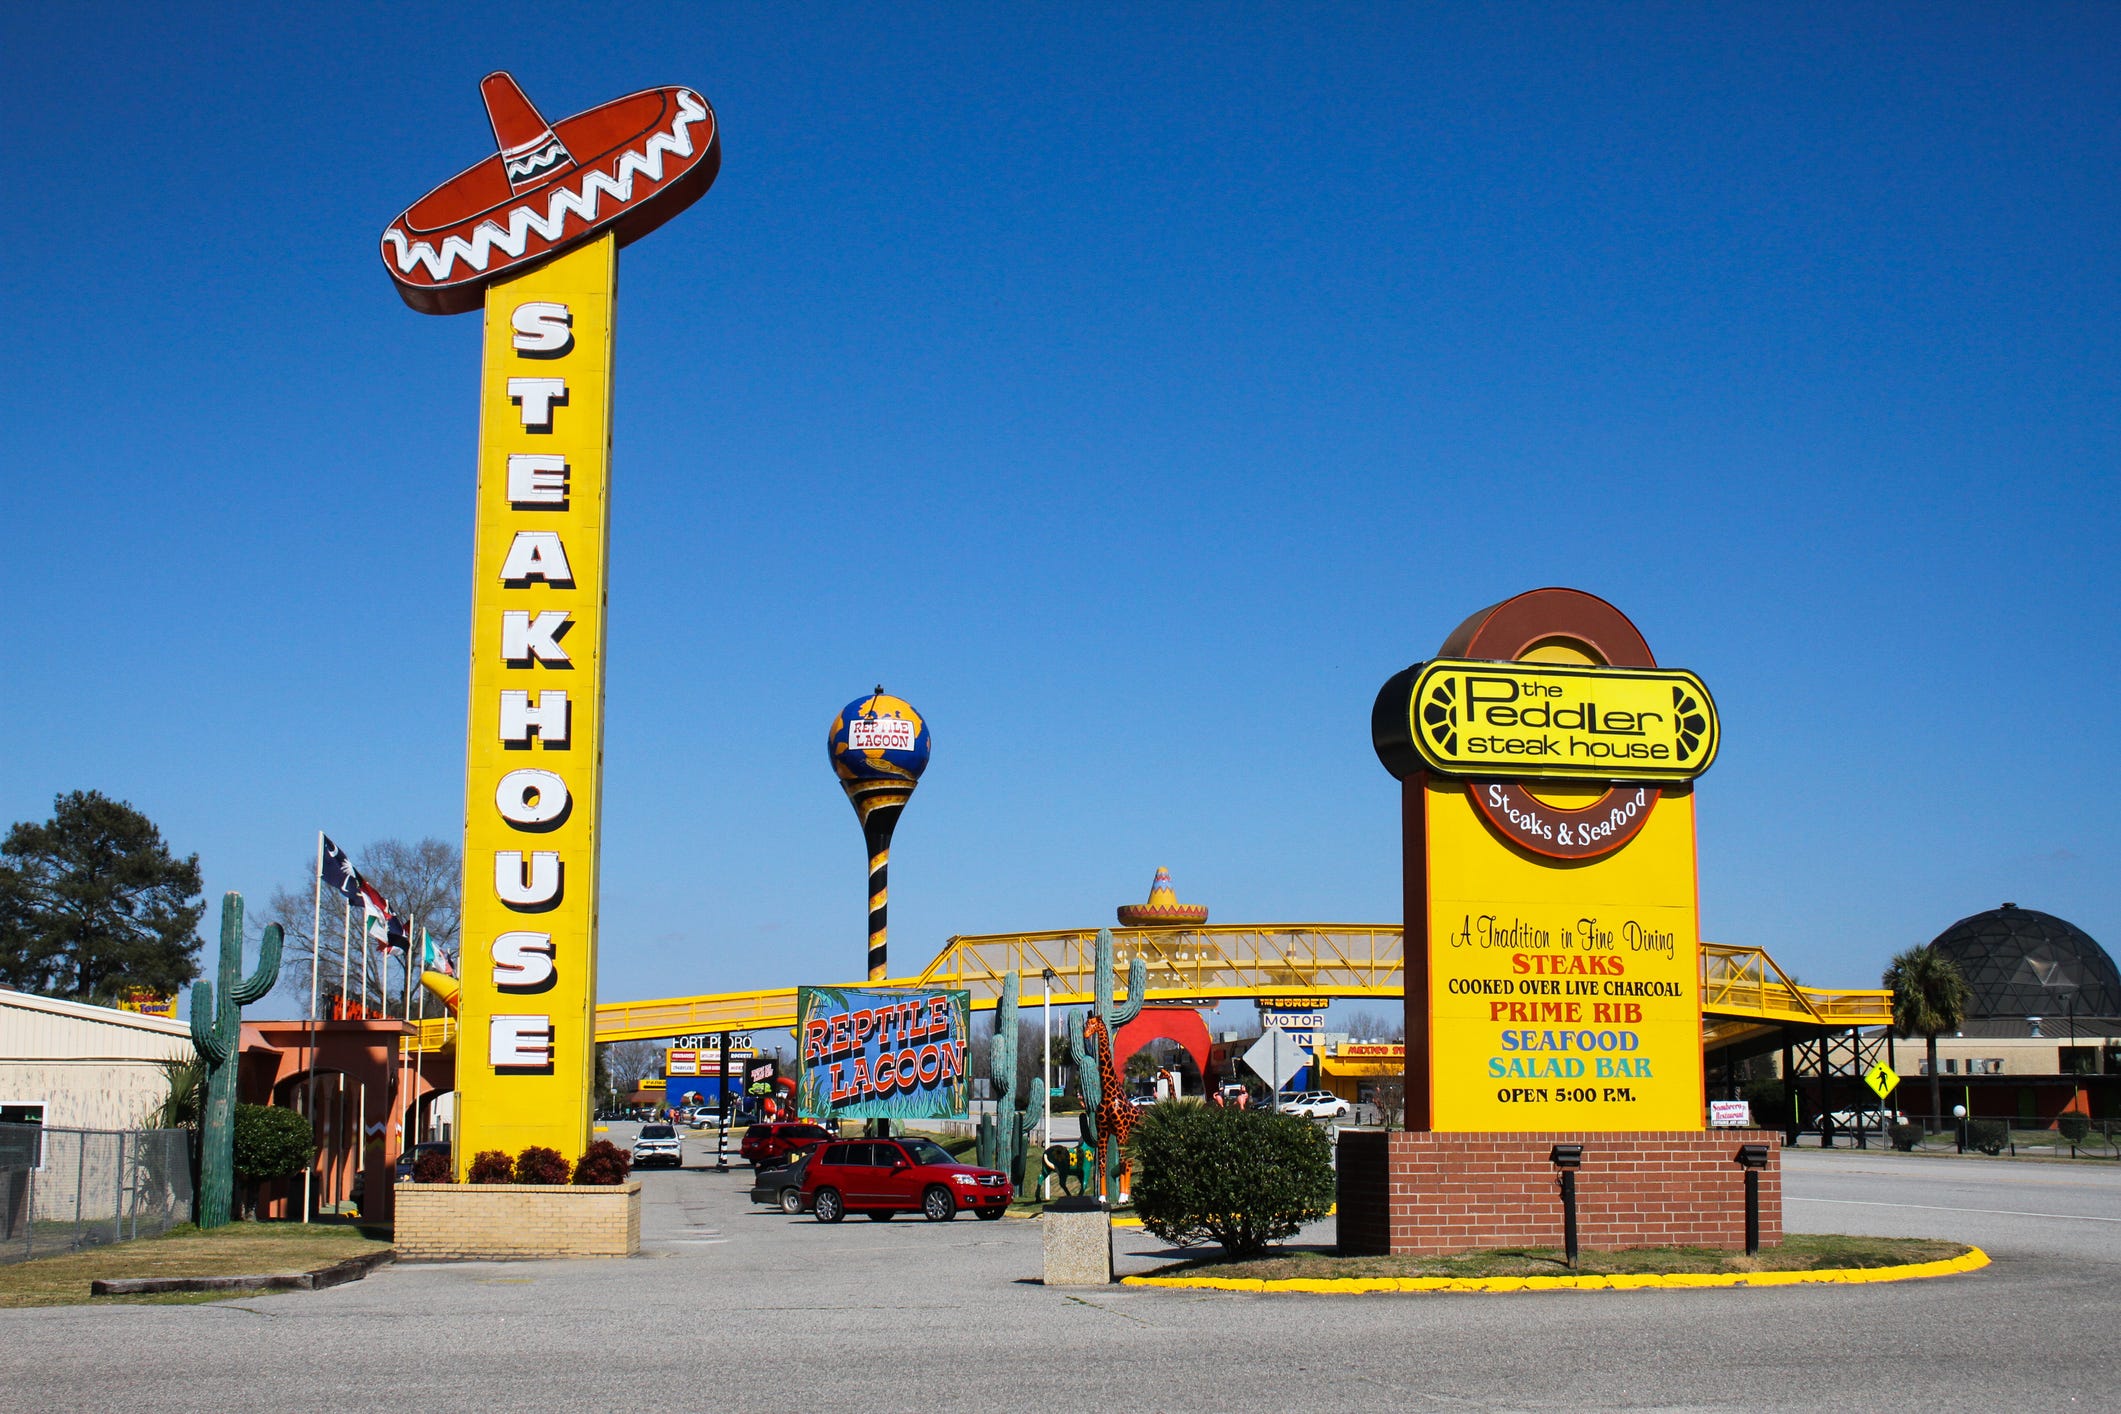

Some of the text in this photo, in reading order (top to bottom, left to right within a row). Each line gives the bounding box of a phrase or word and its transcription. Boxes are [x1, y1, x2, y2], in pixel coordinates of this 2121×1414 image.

[1521, 681, 1563, 699] the
[854, 722, 909, 735] REPTILE
[856, 735, 909, 748] LAGOON
[1467, 735, 1670, 760] steak house
[1488, 784, 1646, 847] Steaks & Seafood
[1451, 914, 1675, 961] A Tradition in Fine Dining
[1511, 953, 1625, 976] STEAKS
[1448, 978, 1683, 998] COOKED OVER LIVE CHARCOAL
[1265, 1015, 1324, 1027] MOTOR
[1489, 1001, 1643, 1024] PRIME RIB
[805, 995, 949, 1060] REPTILE
[672, 1036, 705, 1049] FORT
[1348, 1046, 1389, 1056] MEXICO
[1501, 1030, 1639, 1052] SEAFOOD
[829, 1040, 966, 1102] LAGOON
[1488, 1057, 1654, 1079] SALAD BAR
[1497, 1088, 1637, 1103] OPEN 5:00 P.M.
